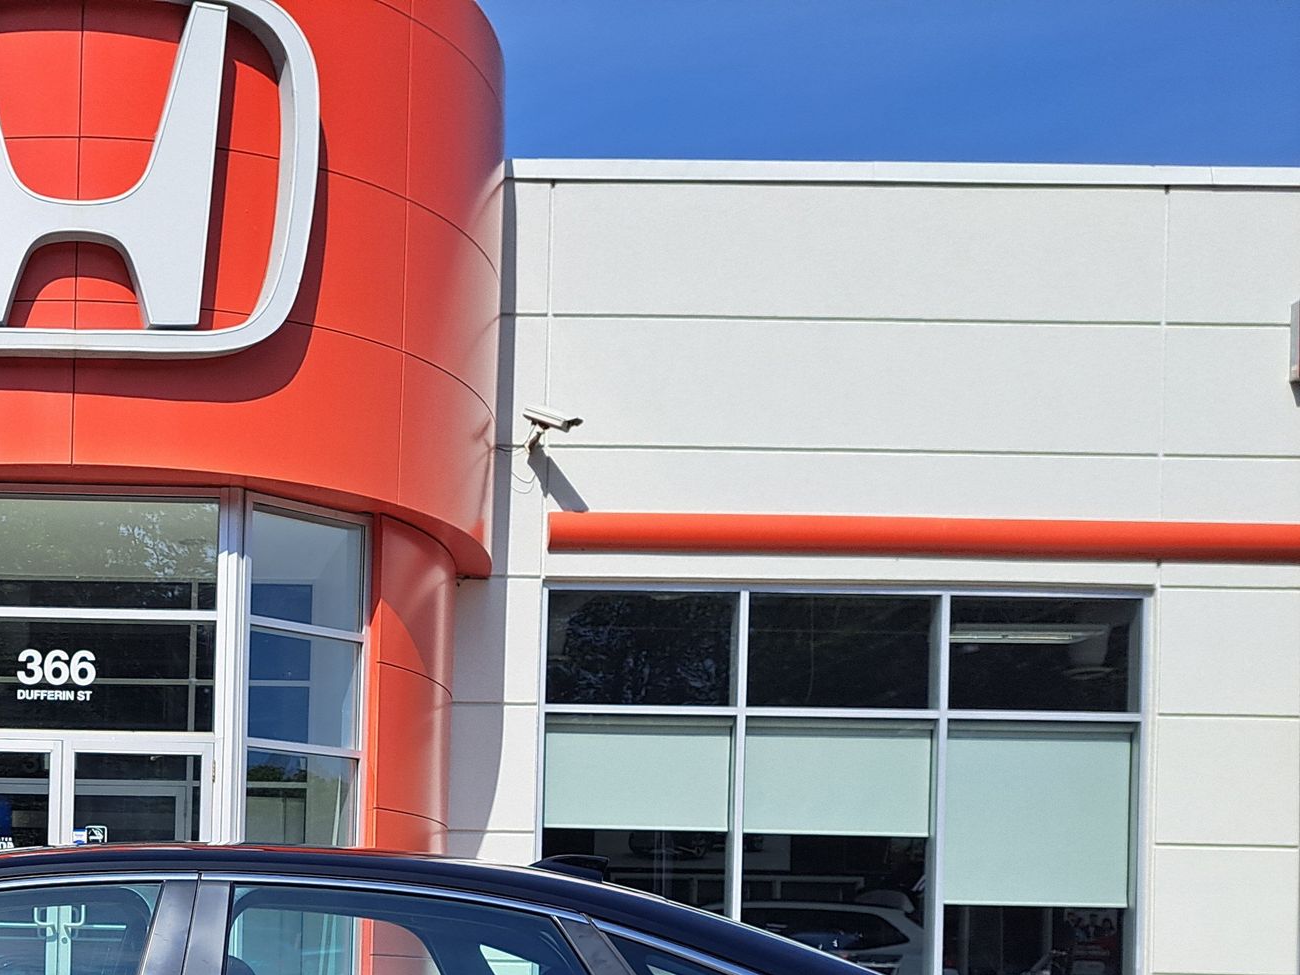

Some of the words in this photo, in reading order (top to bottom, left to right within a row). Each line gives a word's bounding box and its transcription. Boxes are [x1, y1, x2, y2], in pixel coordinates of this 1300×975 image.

[16, 648, 97, 686] 366
[16, 689, 75, 701] DUFFERIN
[76, 690, 93, 702] ST
